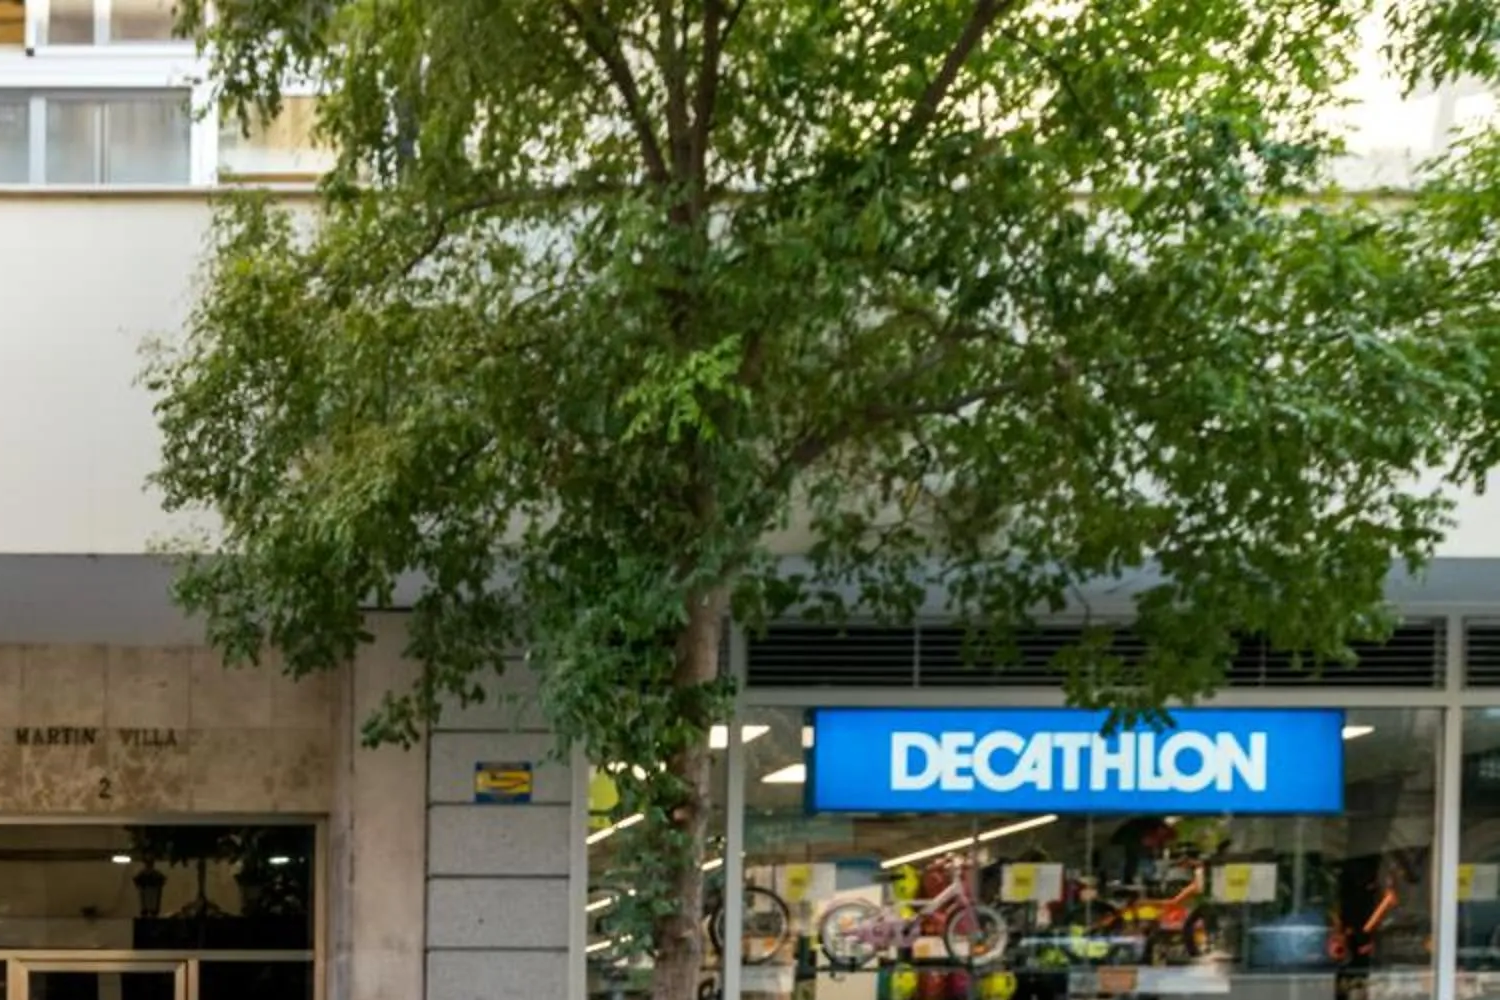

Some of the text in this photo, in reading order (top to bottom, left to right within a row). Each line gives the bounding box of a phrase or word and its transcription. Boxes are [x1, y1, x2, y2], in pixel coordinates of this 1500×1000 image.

[15, 725, 178, 746] MARTIN VILLA
[890, 729, 1268, 792] DECATHLON
[98, 777, 111, 799] 2
